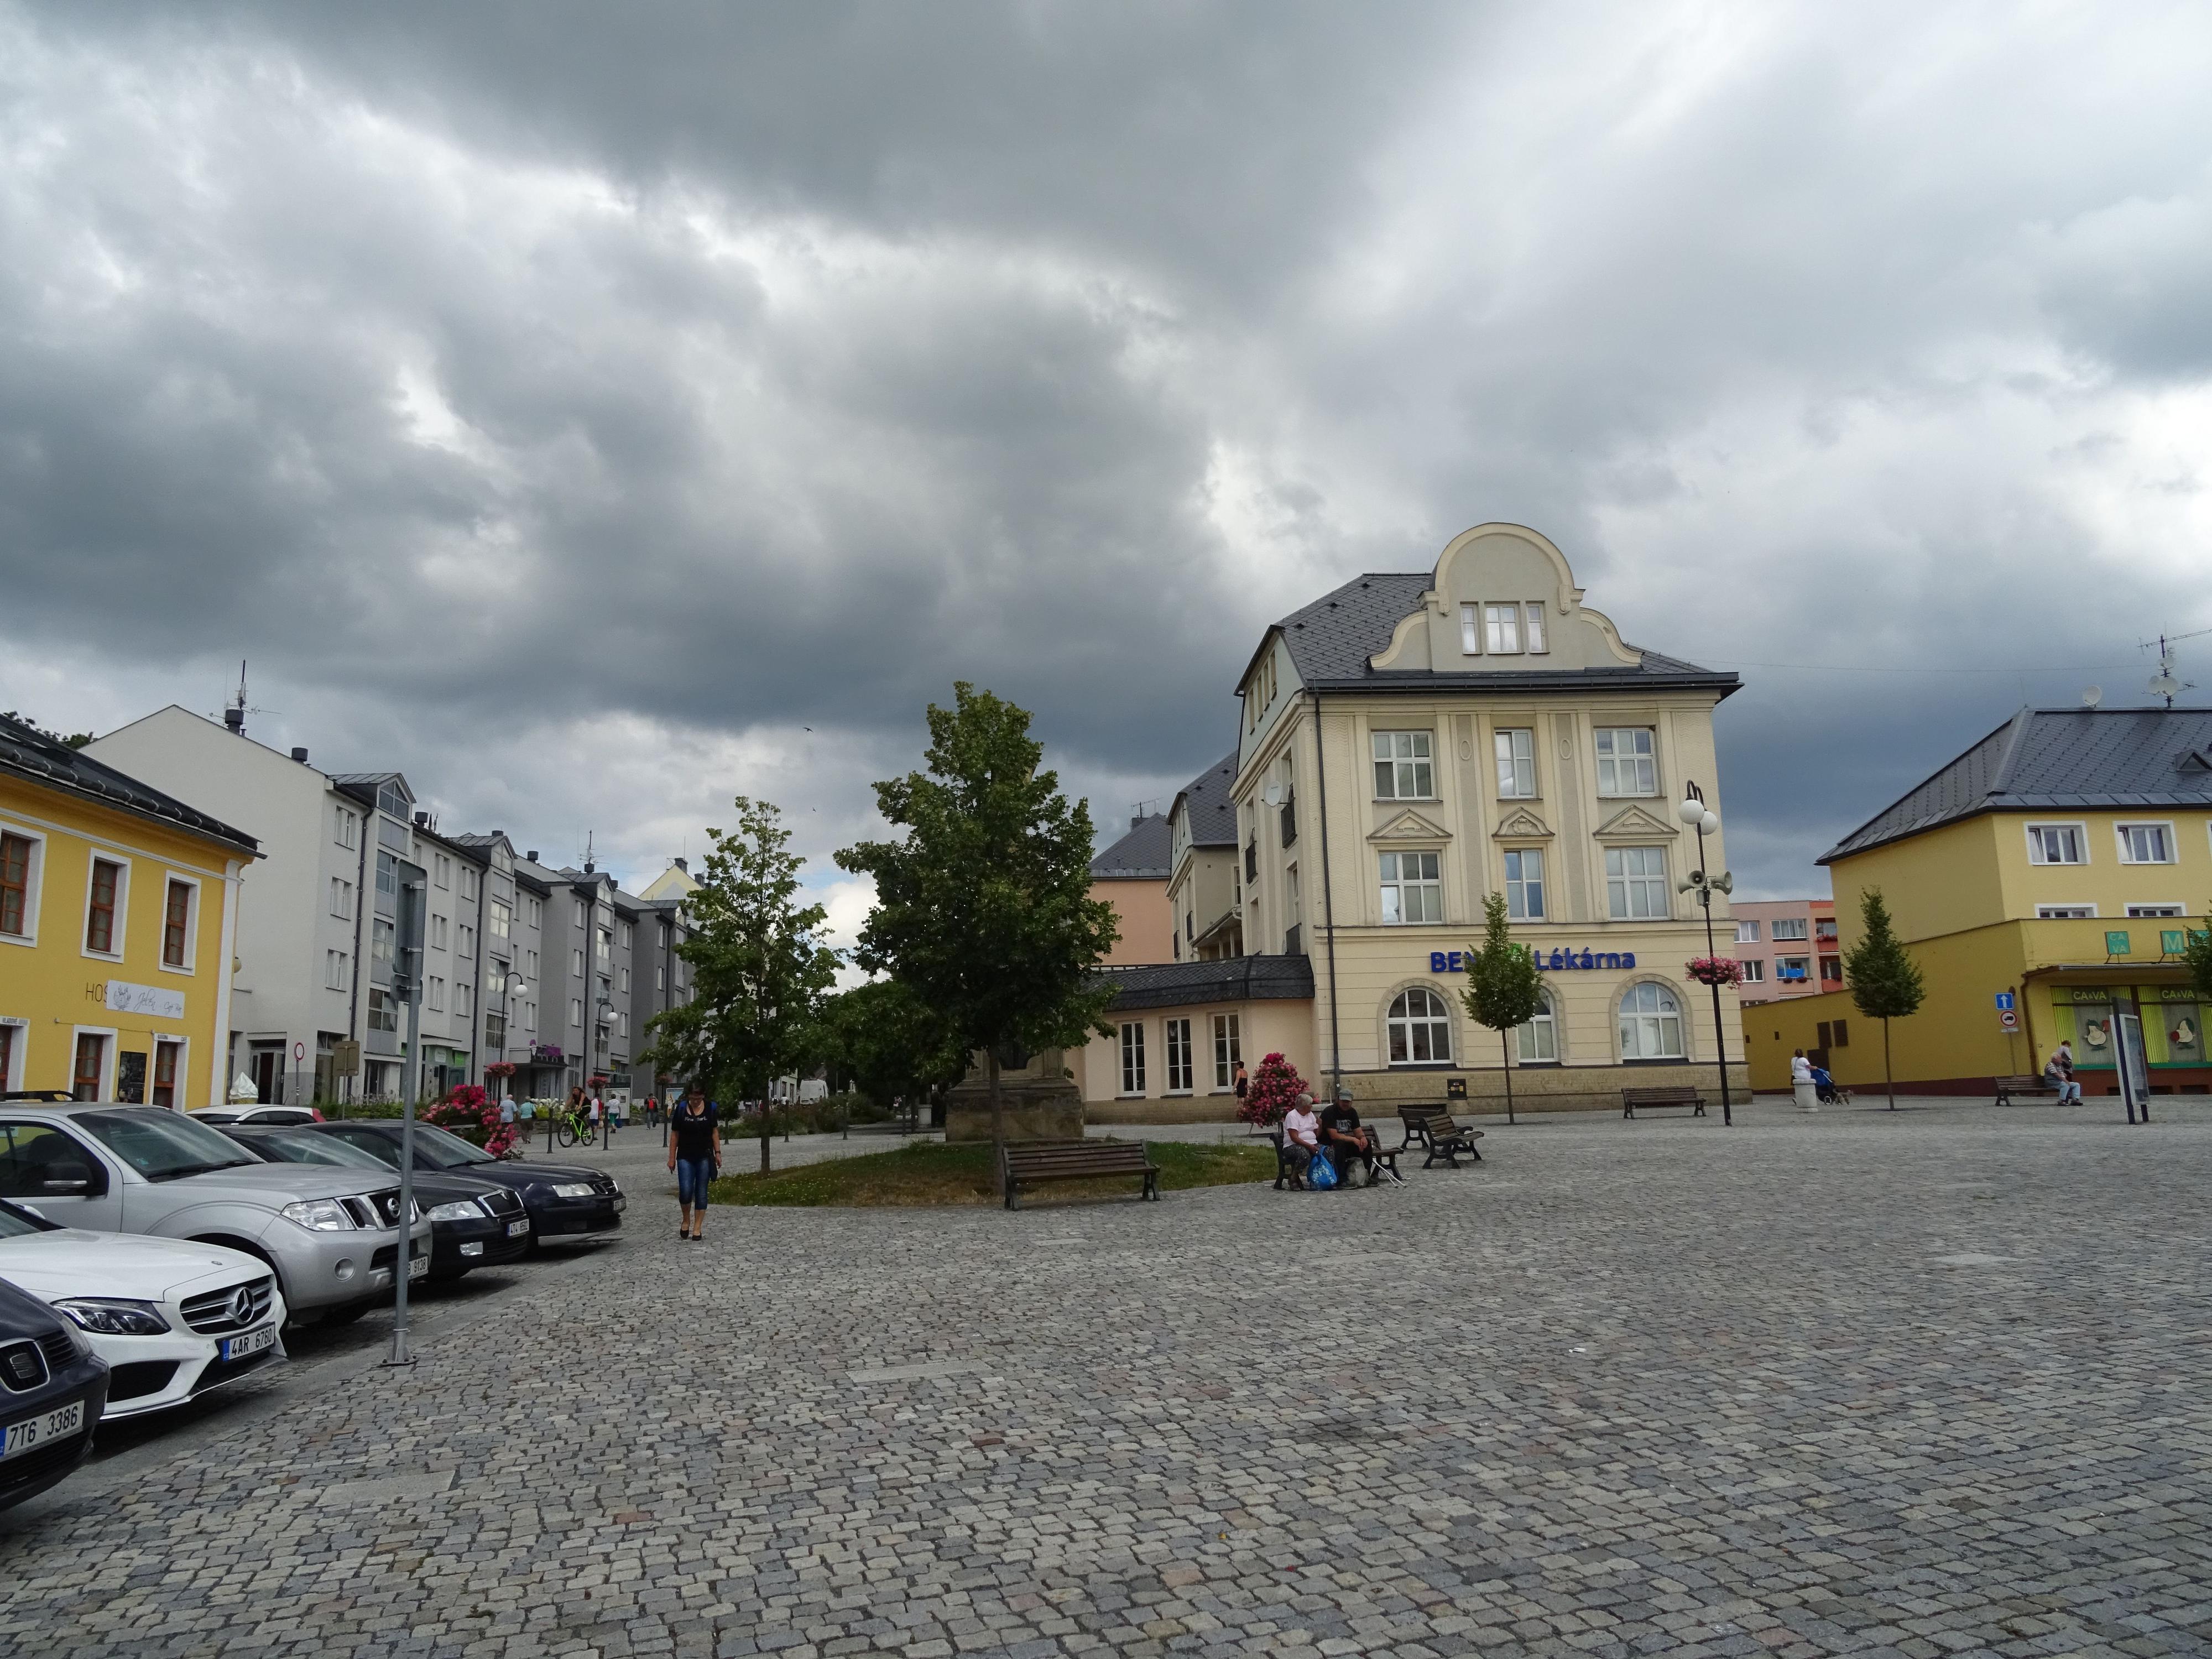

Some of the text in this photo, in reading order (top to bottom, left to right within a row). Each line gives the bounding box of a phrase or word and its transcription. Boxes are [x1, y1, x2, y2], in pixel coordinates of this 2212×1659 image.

[1534, 946, 1636, 971] Lékárna
[232, 1328, 272, 1355] 4AR 6760
[8, 1405, 78, 1451] 7T6 3386
